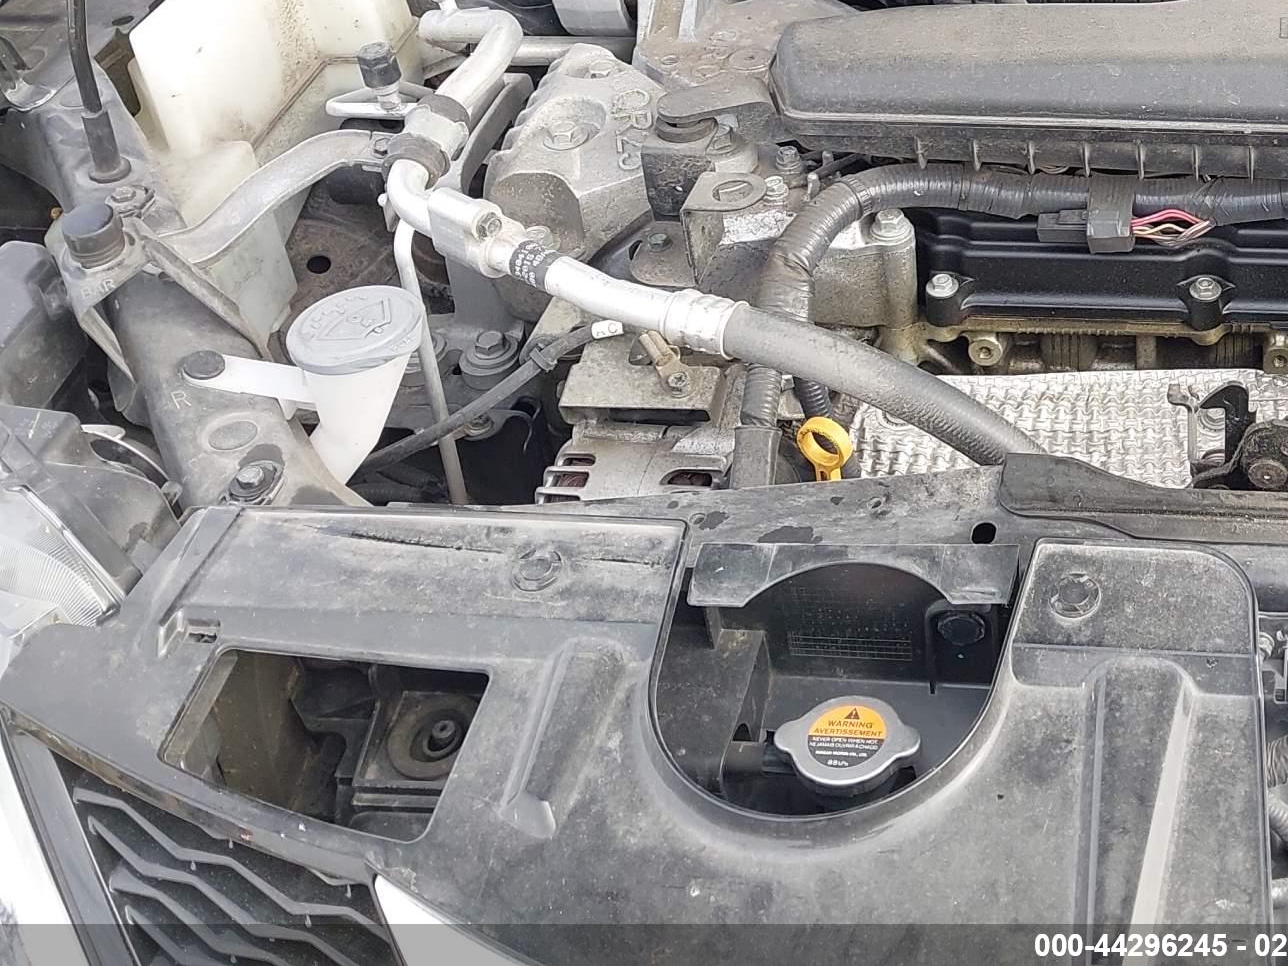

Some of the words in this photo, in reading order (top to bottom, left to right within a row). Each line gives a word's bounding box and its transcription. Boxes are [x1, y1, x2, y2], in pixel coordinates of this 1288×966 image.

[171, 390, 192, 410] R
[828, 719, 874, 729] WARNING
[813, 728, 883, 737] AVERTISSEMENT
